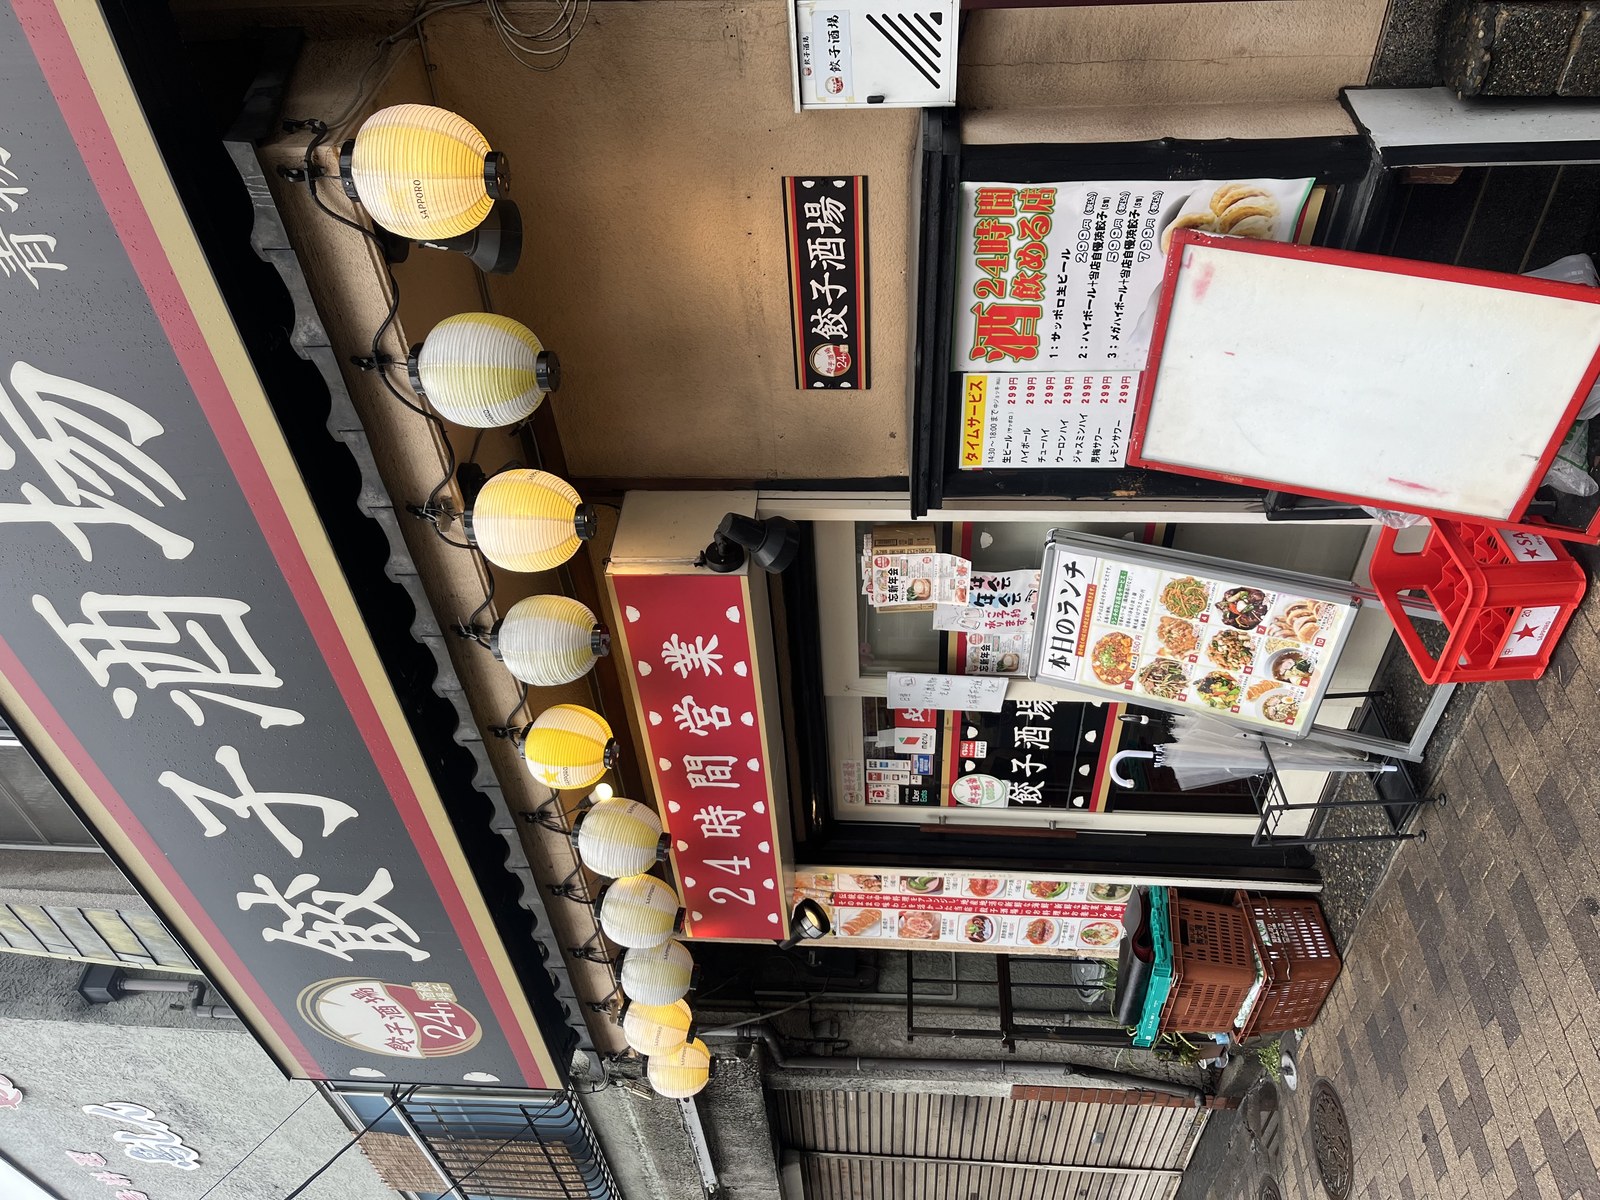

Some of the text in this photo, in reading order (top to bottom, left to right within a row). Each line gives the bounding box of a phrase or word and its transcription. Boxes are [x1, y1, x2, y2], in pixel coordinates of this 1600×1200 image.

[802, 35, 811, 65] 餃子酒場
[826, 14, 842, 73] 餃子酒場
[412, 179, 430, 220] SAPPORO
[803, 195, 849, 340] 餃子酒場
[972, 186, 1018, 300] 24時間
[1010, 186, 1058, 301] 飲める店
[969, 302, 1042, 363] 酒
[964, 380, 984, 461] タイムサービス
[1007, 377, 1019, 405] 299円
[1020, 376, 1037, 463] ハイボール 299円
[1037, 376, 1056, 463] チューハイ 299円
[1055, 376, 1075, 463] ウーロンハイ 299円
[1072, 376, 1094, 463] ジャスミンハイ 299円
[1090, 375, 1112, 463] 男梅サワー 299円
[1108, 375, 1132, 463] レモンサワー 299円
[887, 567, 899, 602] 忘新年会
[985, 608, 1022, 619] ご予約
[1521, 609, 1532, 618] 20
[984, 617, 1028, 629] 承ります。
[1047, 560, 1086, 672] 本日のランチ
[1132, 634, 1143, 653] 550円
[1316, 636, 1325, 646] 10
[1537, 620, 1551, 640] SAPPORO
[0, 361, 432, 961] 餃子酒場
[980, 644, 991, 673] 忘新年会
[661, 632, 756, 906] 24時間営業
[920, 732, 929, 750] menu
[1007, 700, 1059, 804] 餃子酒場
[912, 789, 920, 803] Uber
[920, 789, 928, 803] Eats
[350, 987, 415, 1052] 餃子酒場
[413, 1002, 467, 1040] 24h
